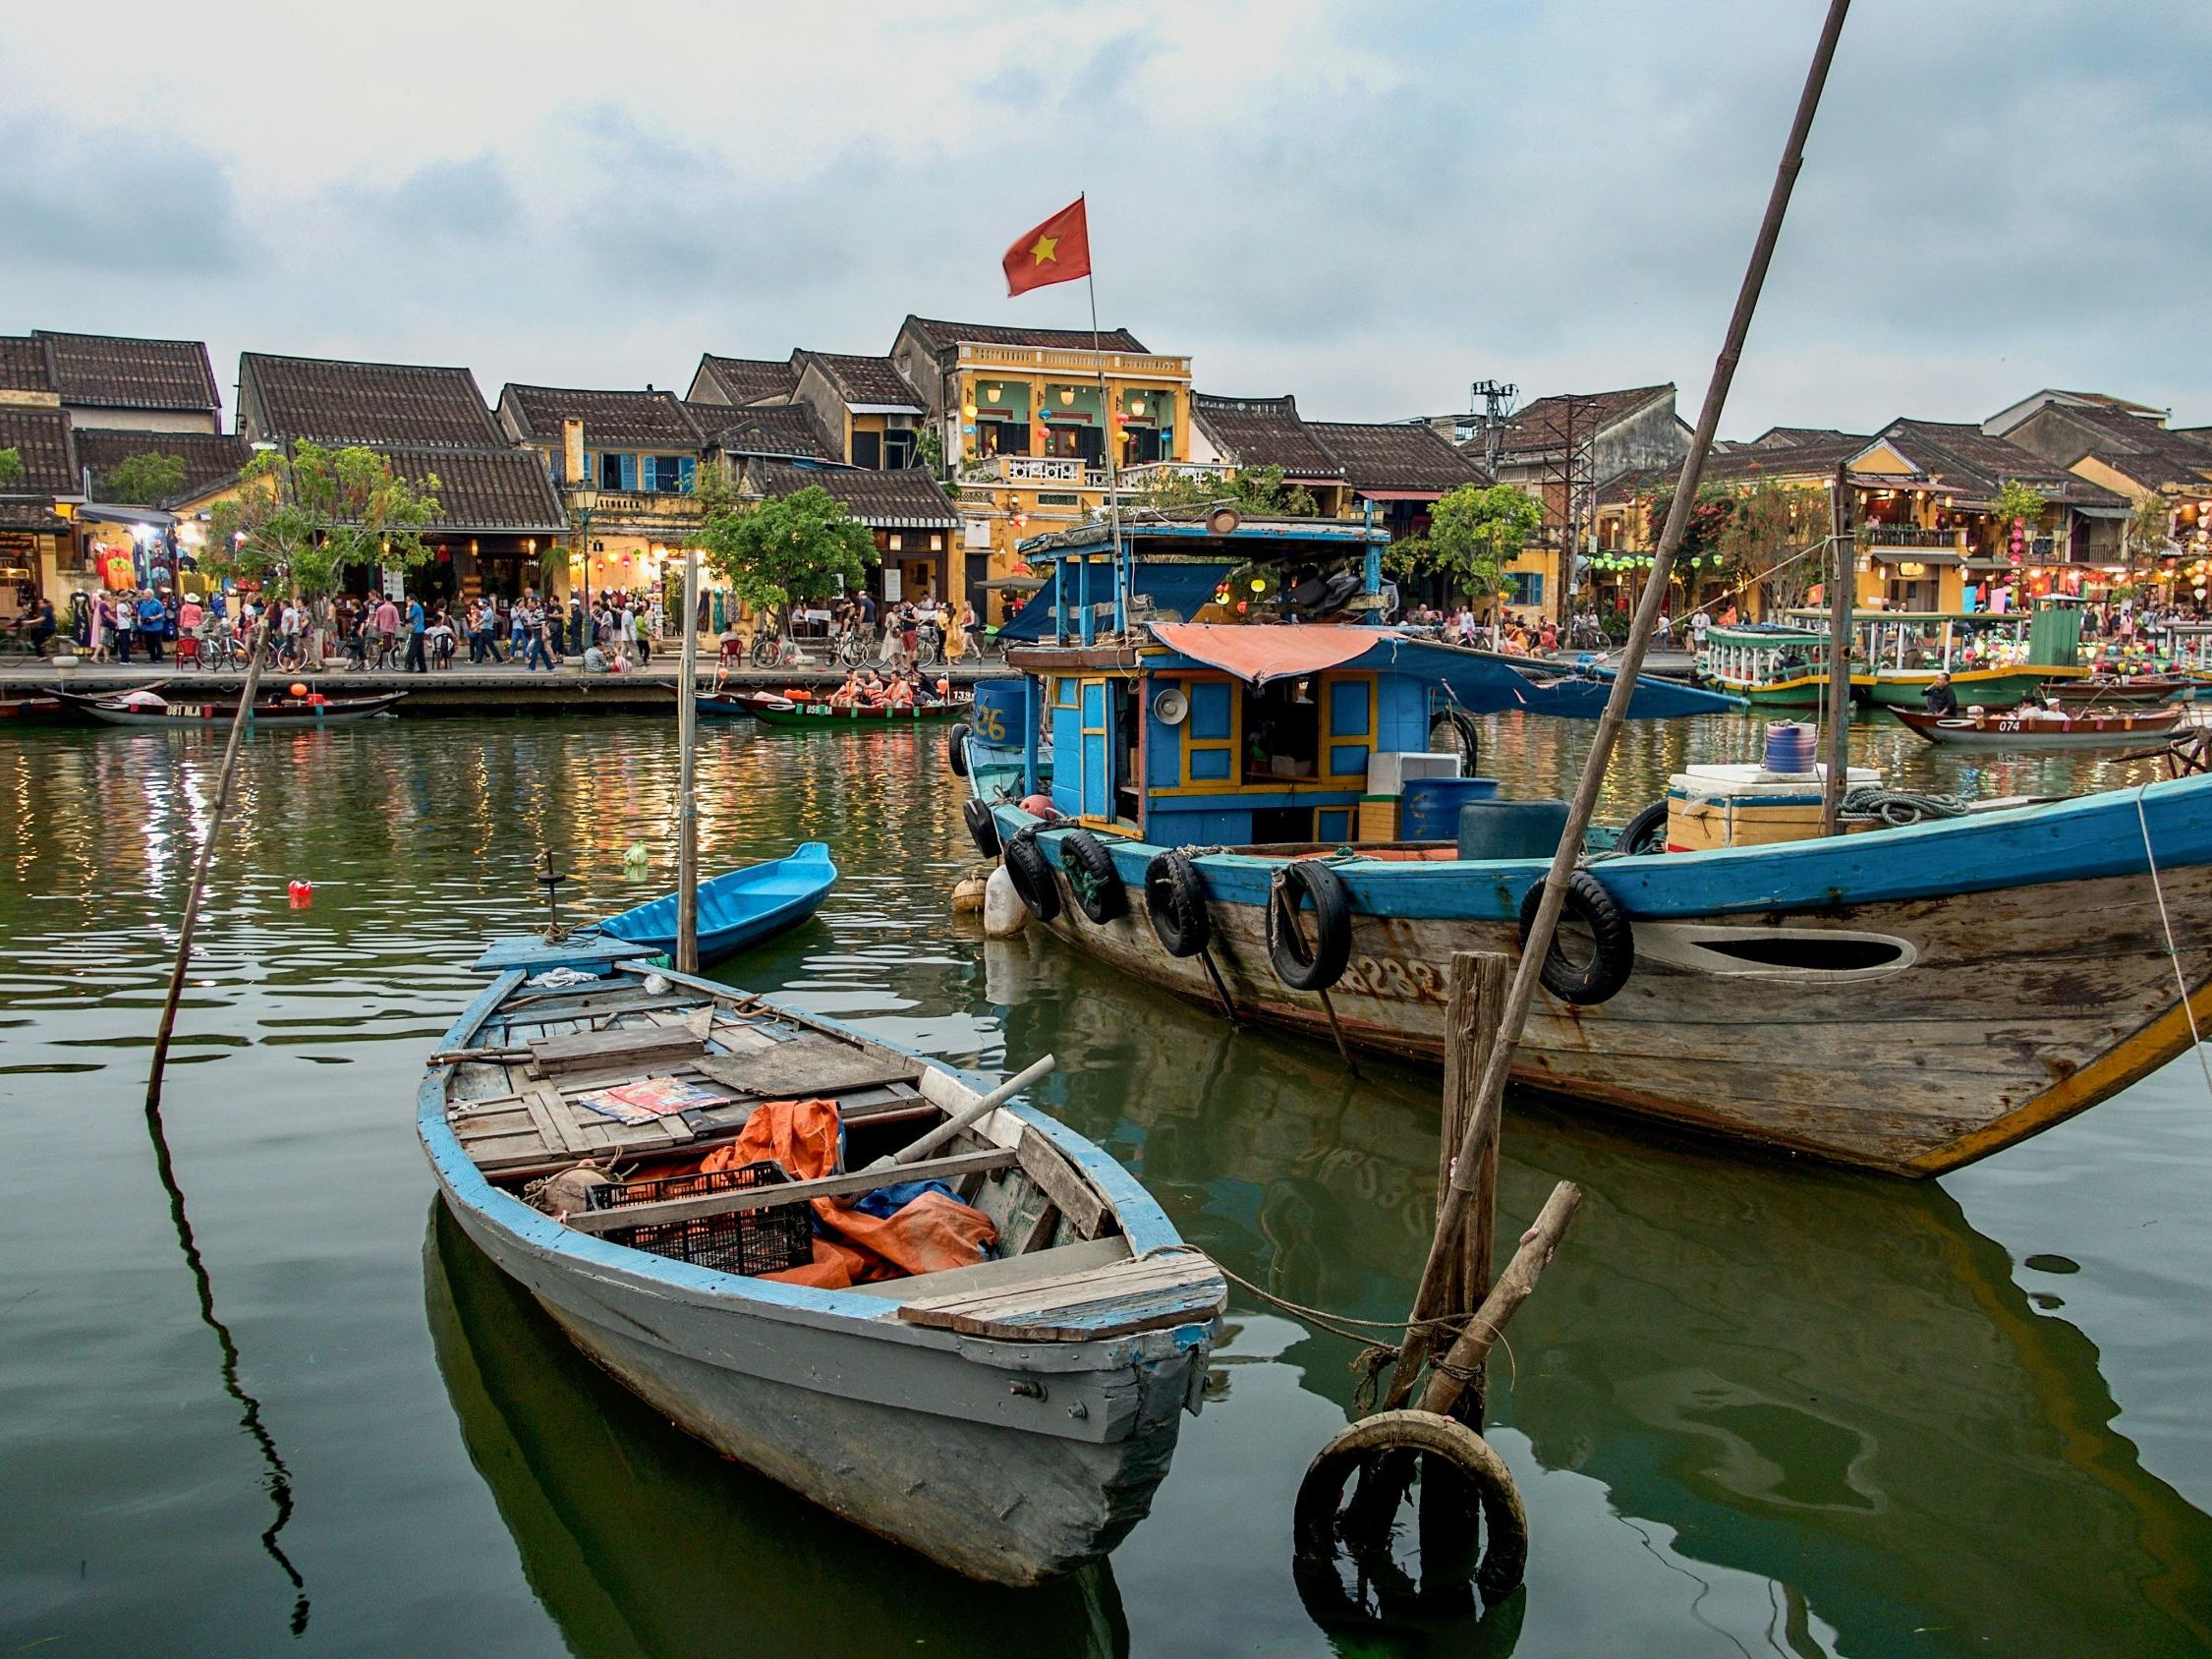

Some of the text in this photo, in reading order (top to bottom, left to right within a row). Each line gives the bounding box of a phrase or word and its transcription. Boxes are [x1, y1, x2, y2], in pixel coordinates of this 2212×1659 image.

[953, 690, 971, 700] 139
[167, 704, 182, 716] 081
[1999, 720, 2020, 731] 074
